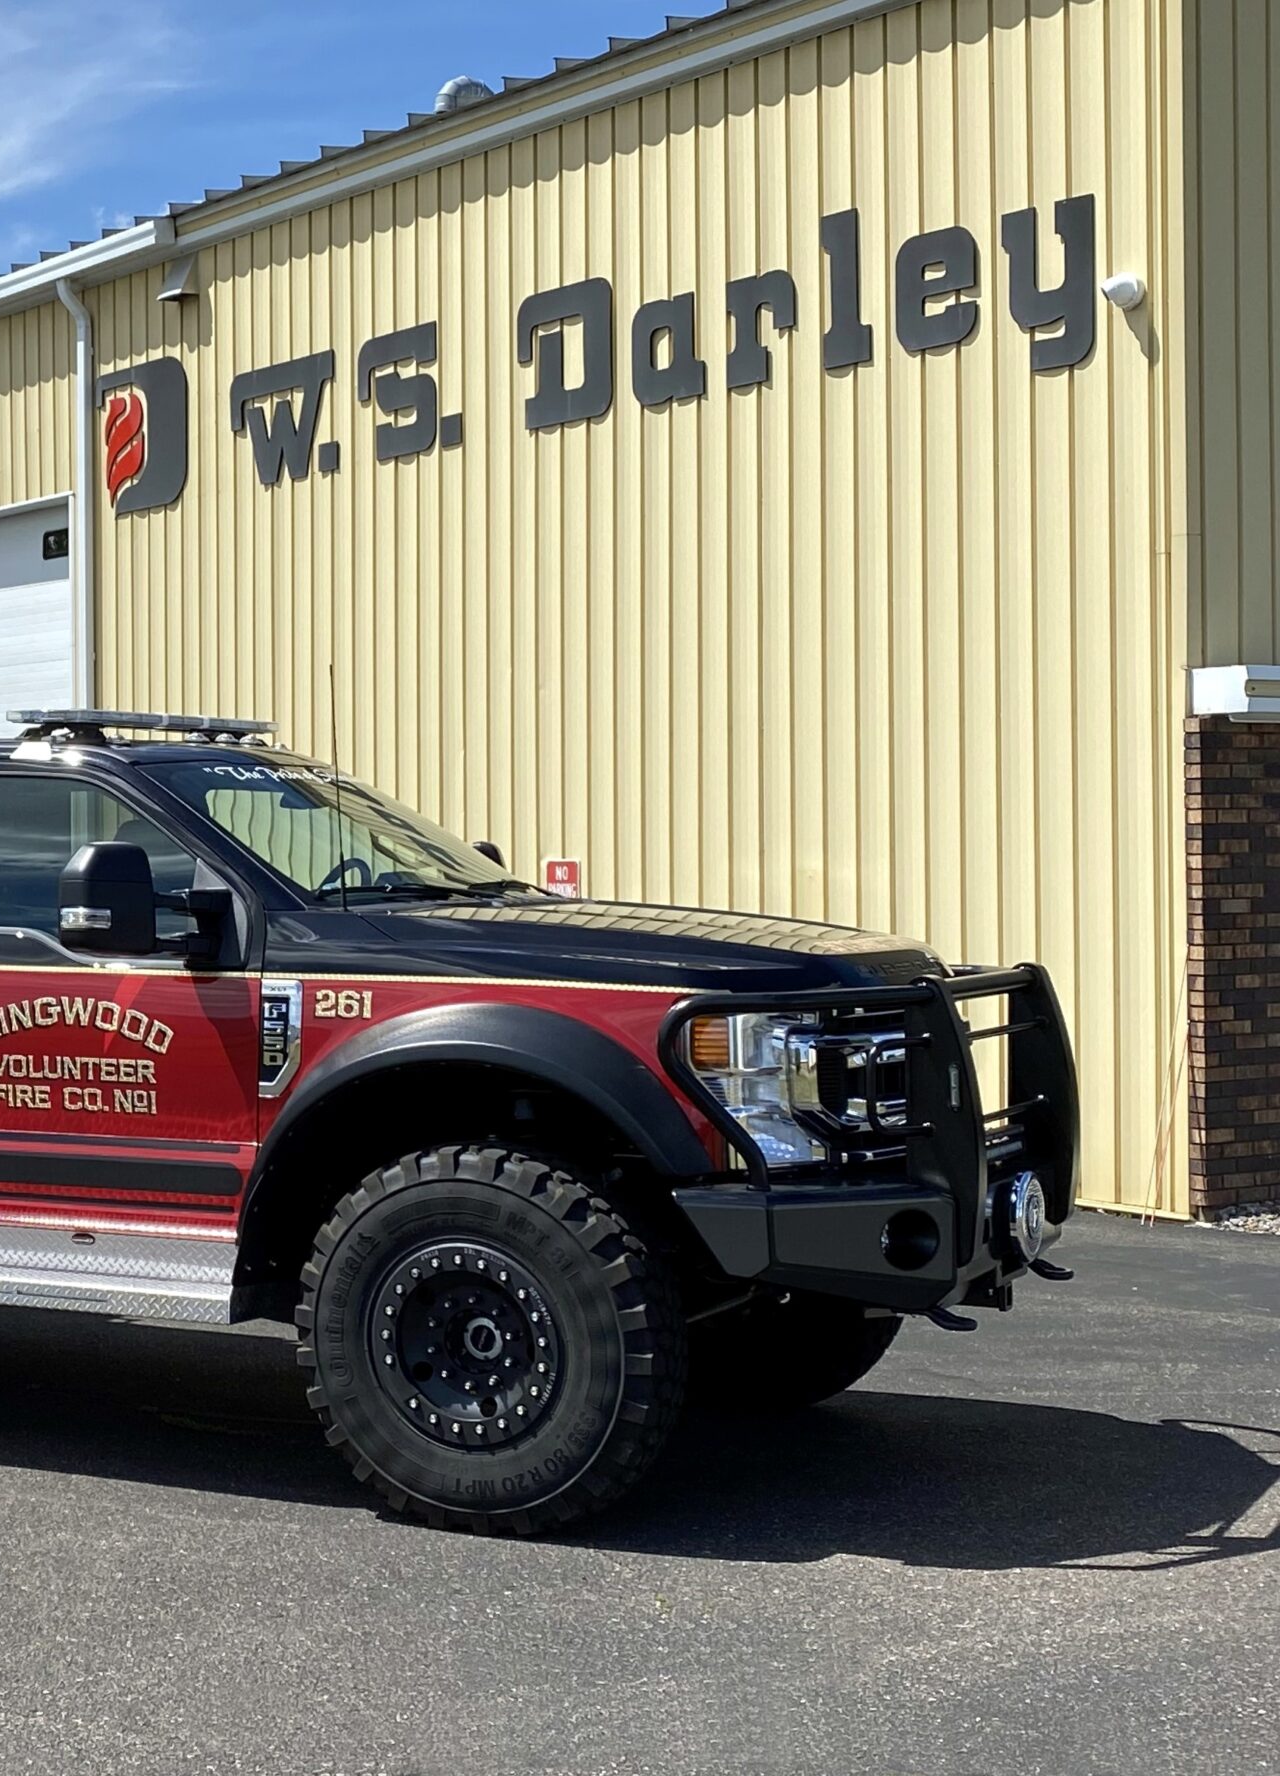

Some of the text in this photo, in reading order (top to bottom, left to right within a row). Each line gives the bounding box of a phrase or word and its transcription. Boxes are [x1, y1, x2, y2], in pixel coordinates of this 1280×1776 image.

[230, 192, 1096, 485] W. S. Darley
[554, 865, 569, 881] NO
[314, 989, 373, 1019] 261
[62, 1087, 110, 1112] CO.
